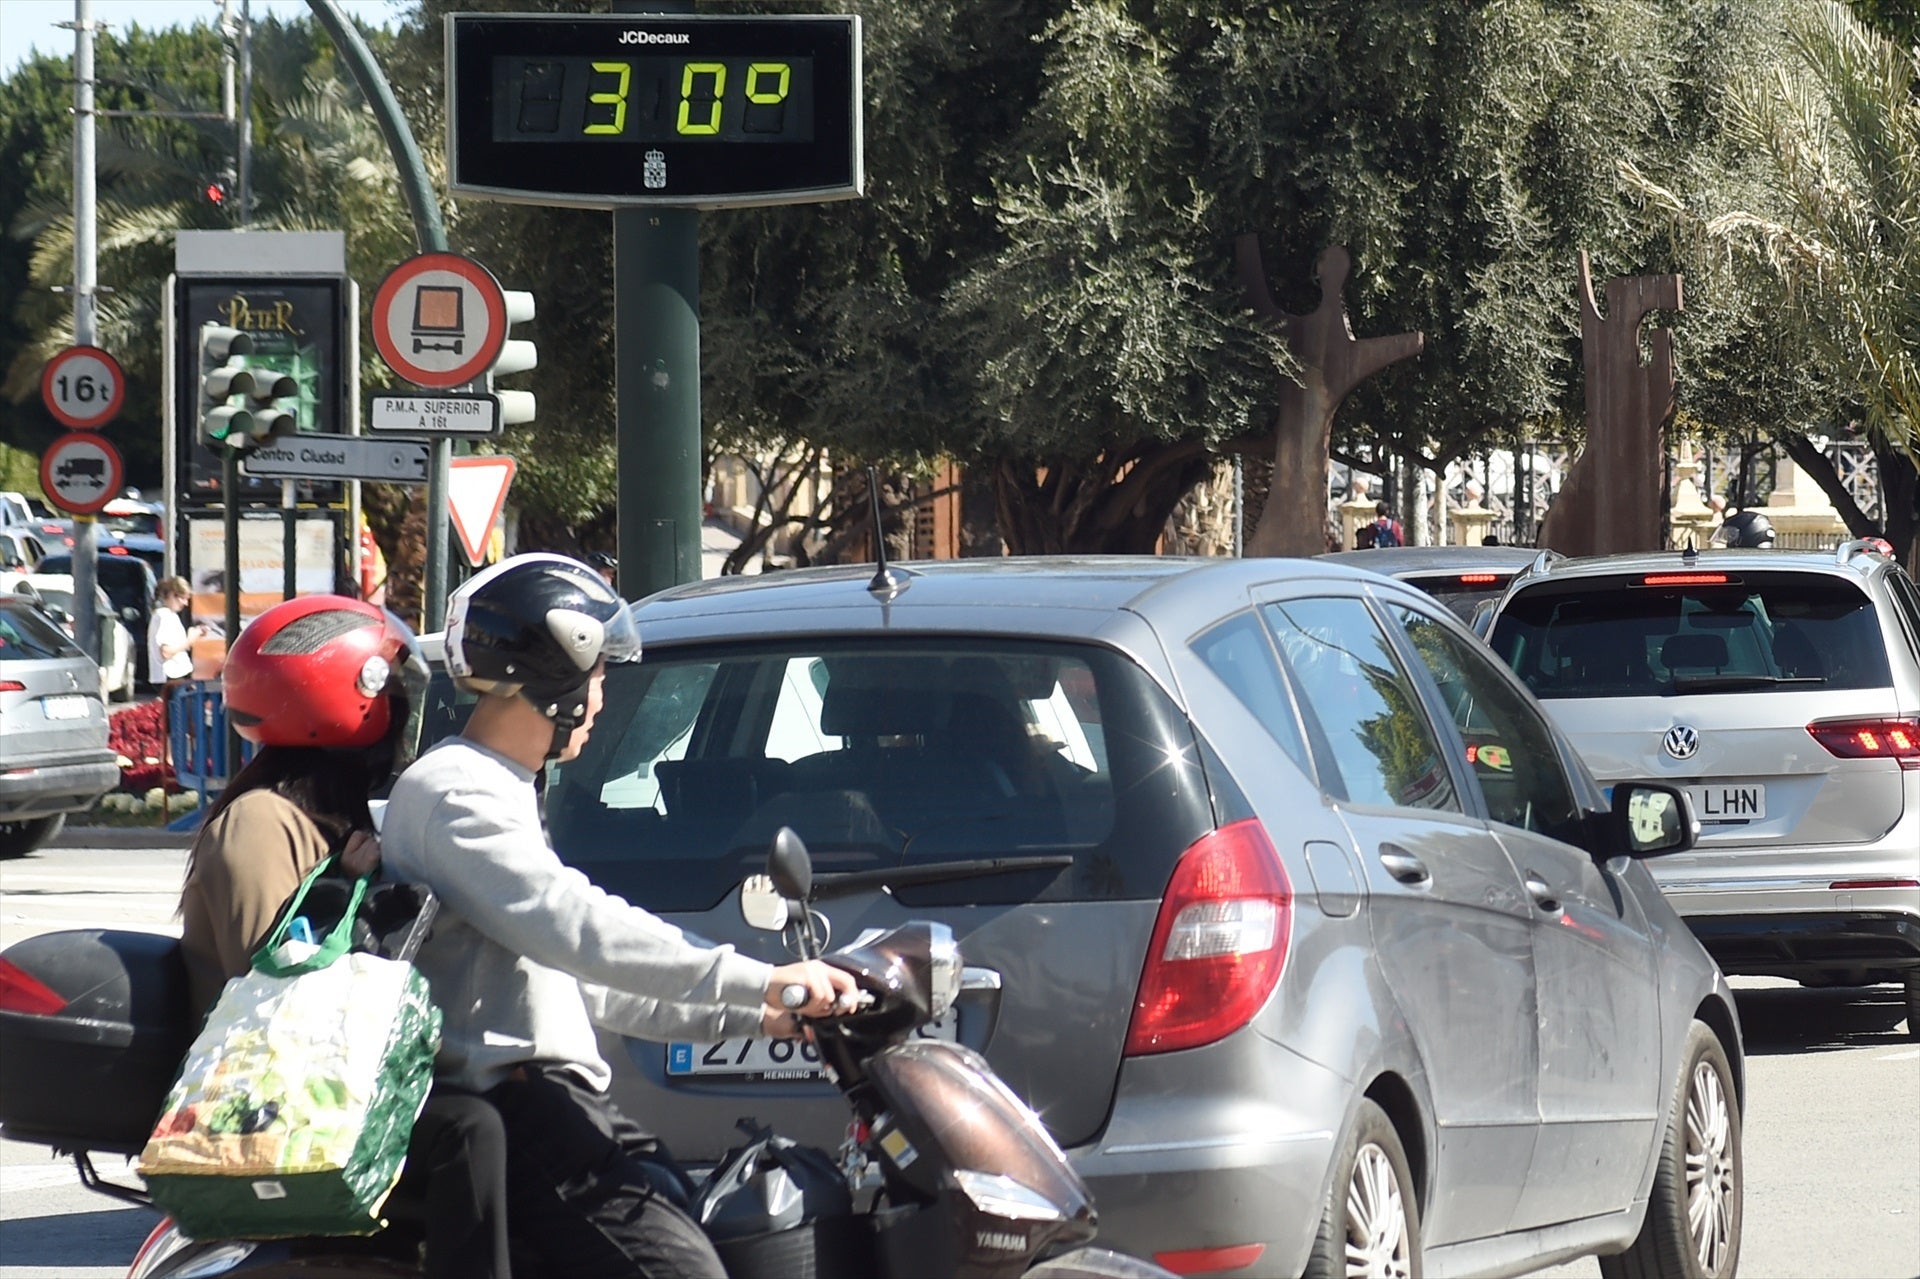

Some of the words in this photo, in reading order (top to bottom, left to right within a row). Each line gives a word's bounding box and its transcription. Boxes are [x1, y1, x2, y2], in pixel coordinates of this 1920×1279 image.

[618, 31, 690, 45] JCDecaux
[385, 401, 418, 413] P.M.A.
[424, 402, 480, 415] SUPERIOR
[419, 416, 425, 427] A
[432, 417, 447, 428] 16t
[251, 448, 295, 462] Centro
[301, 449, 345, 464] Ciudad
[1705, 789, 1757, 814] LHN
[676, 1050, 687, 1063] E
[763, 1070, 811, 1080] HENNING
[976, 1232, 1027, 1250] YAMAHA
